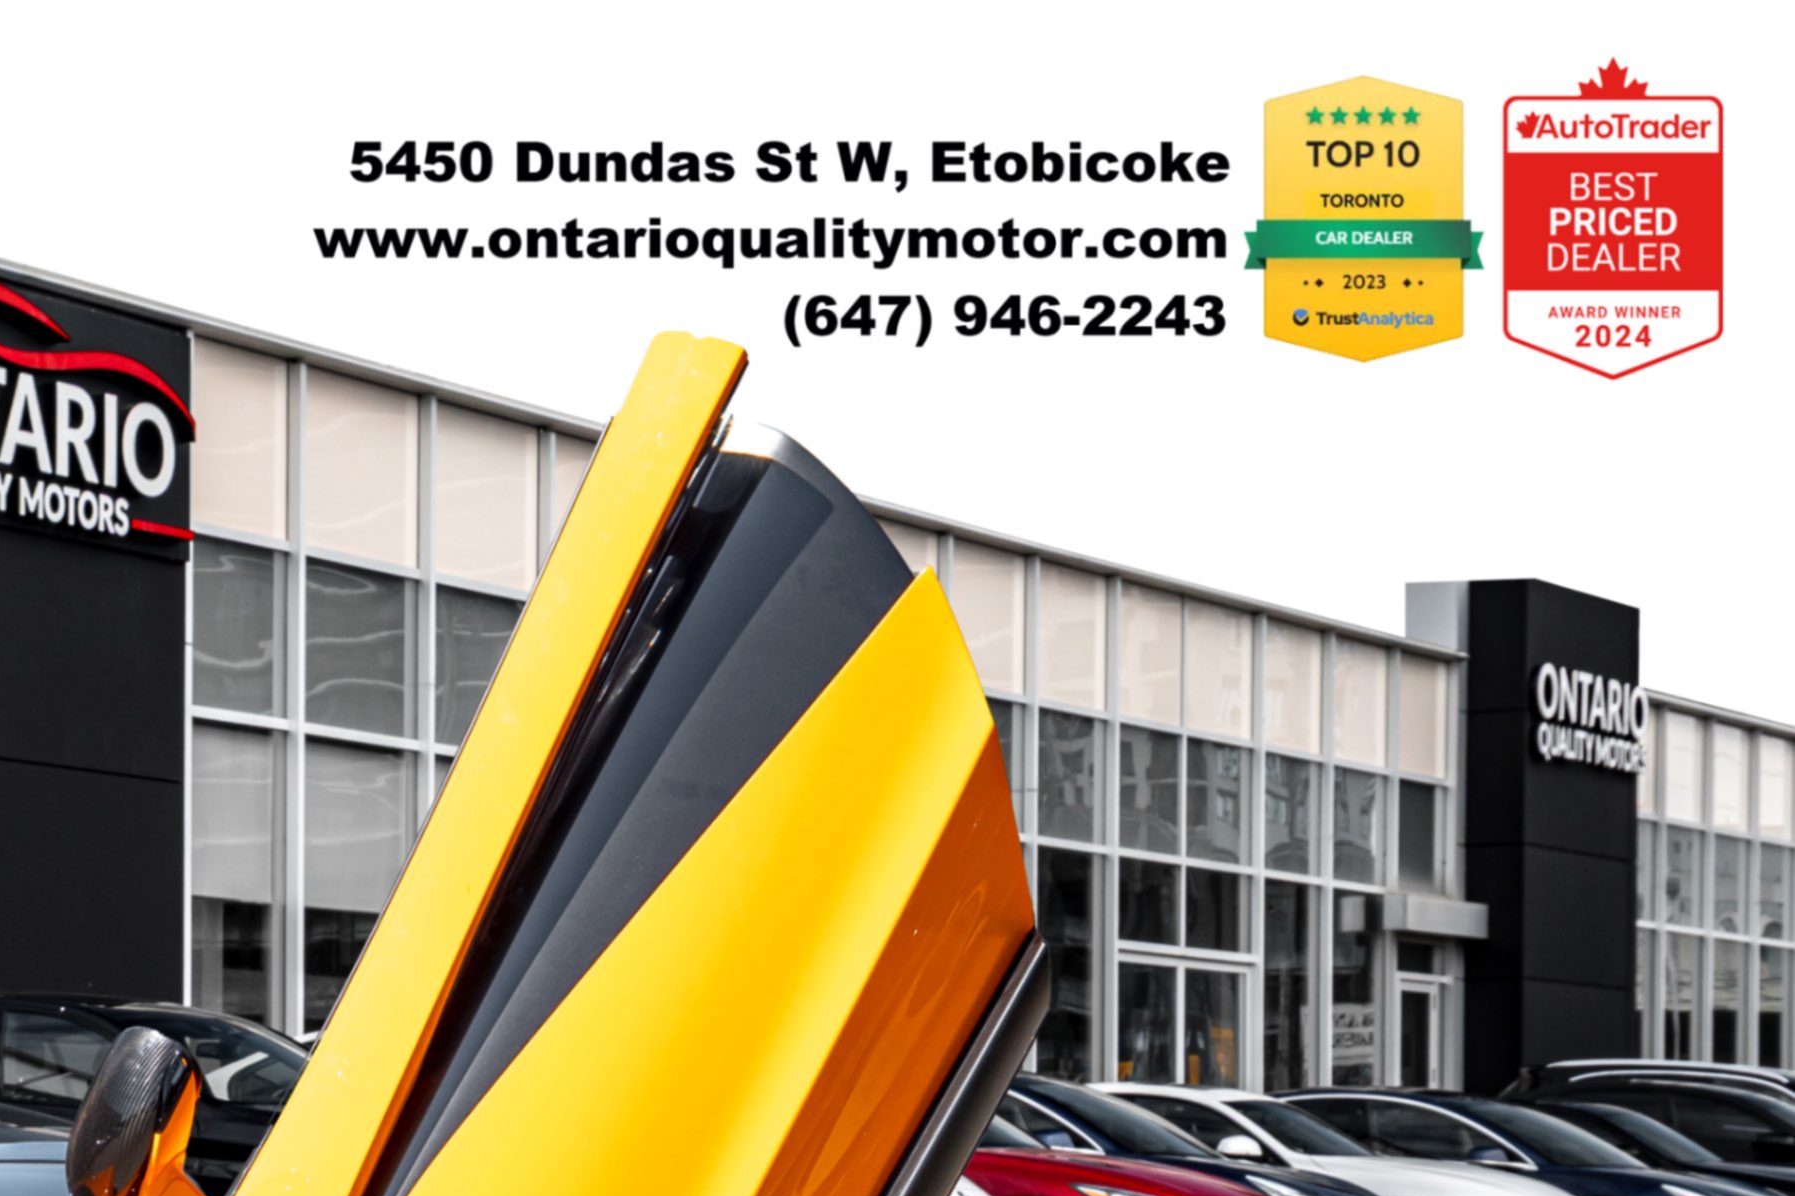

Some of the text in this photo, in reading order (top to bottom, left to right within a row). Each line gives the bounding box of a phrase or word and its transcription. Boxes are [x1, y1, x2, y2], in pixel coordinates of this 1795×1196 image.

[18, 476, 131, 537] MOTORS
[1537, 662, 1649, 739] ONTARIO
[1537, 721, 1594, 764] QUALITY
